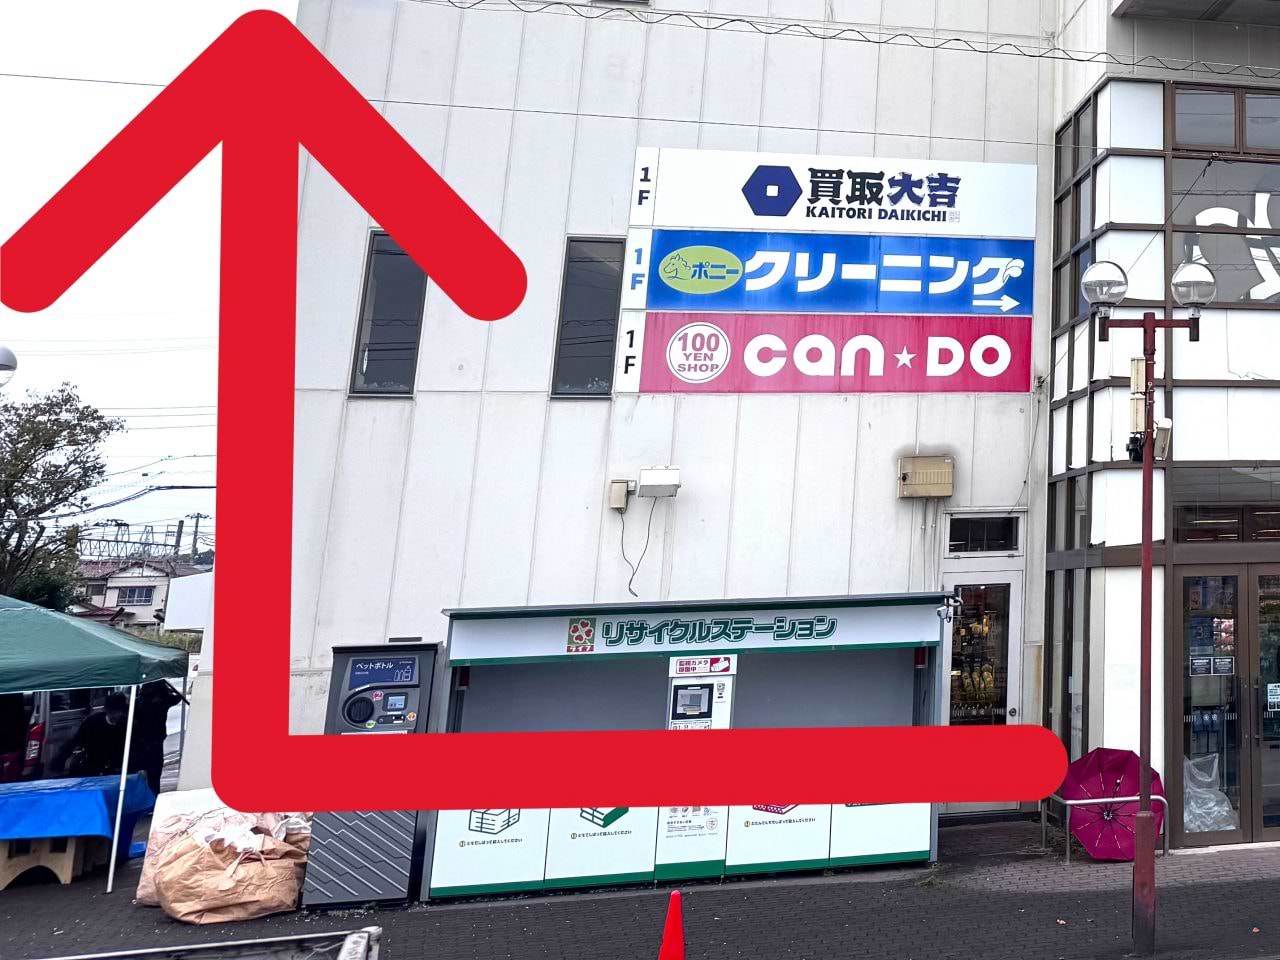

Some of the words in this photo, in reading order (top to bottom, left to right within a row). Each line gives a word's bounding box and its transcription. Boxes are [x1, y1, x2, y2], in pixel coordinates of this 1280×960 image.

[807, 168, 961, 208] 買取大吉
[806, 206, 872, 219] KAITORI
[878, 209, 947, 222] DAIKICHI
[691, 261, 739, 280] ポニー
[745, 251, 1024, 295] クリーニング
[677, 332, 720, 352] 100
[683, 352, 714, 362] YEN
[677, 363, 720, 373] SHOP
[602, 616, 837, 646] リサイクルステーション
[356, 662, 393, 670] ペットボトル
